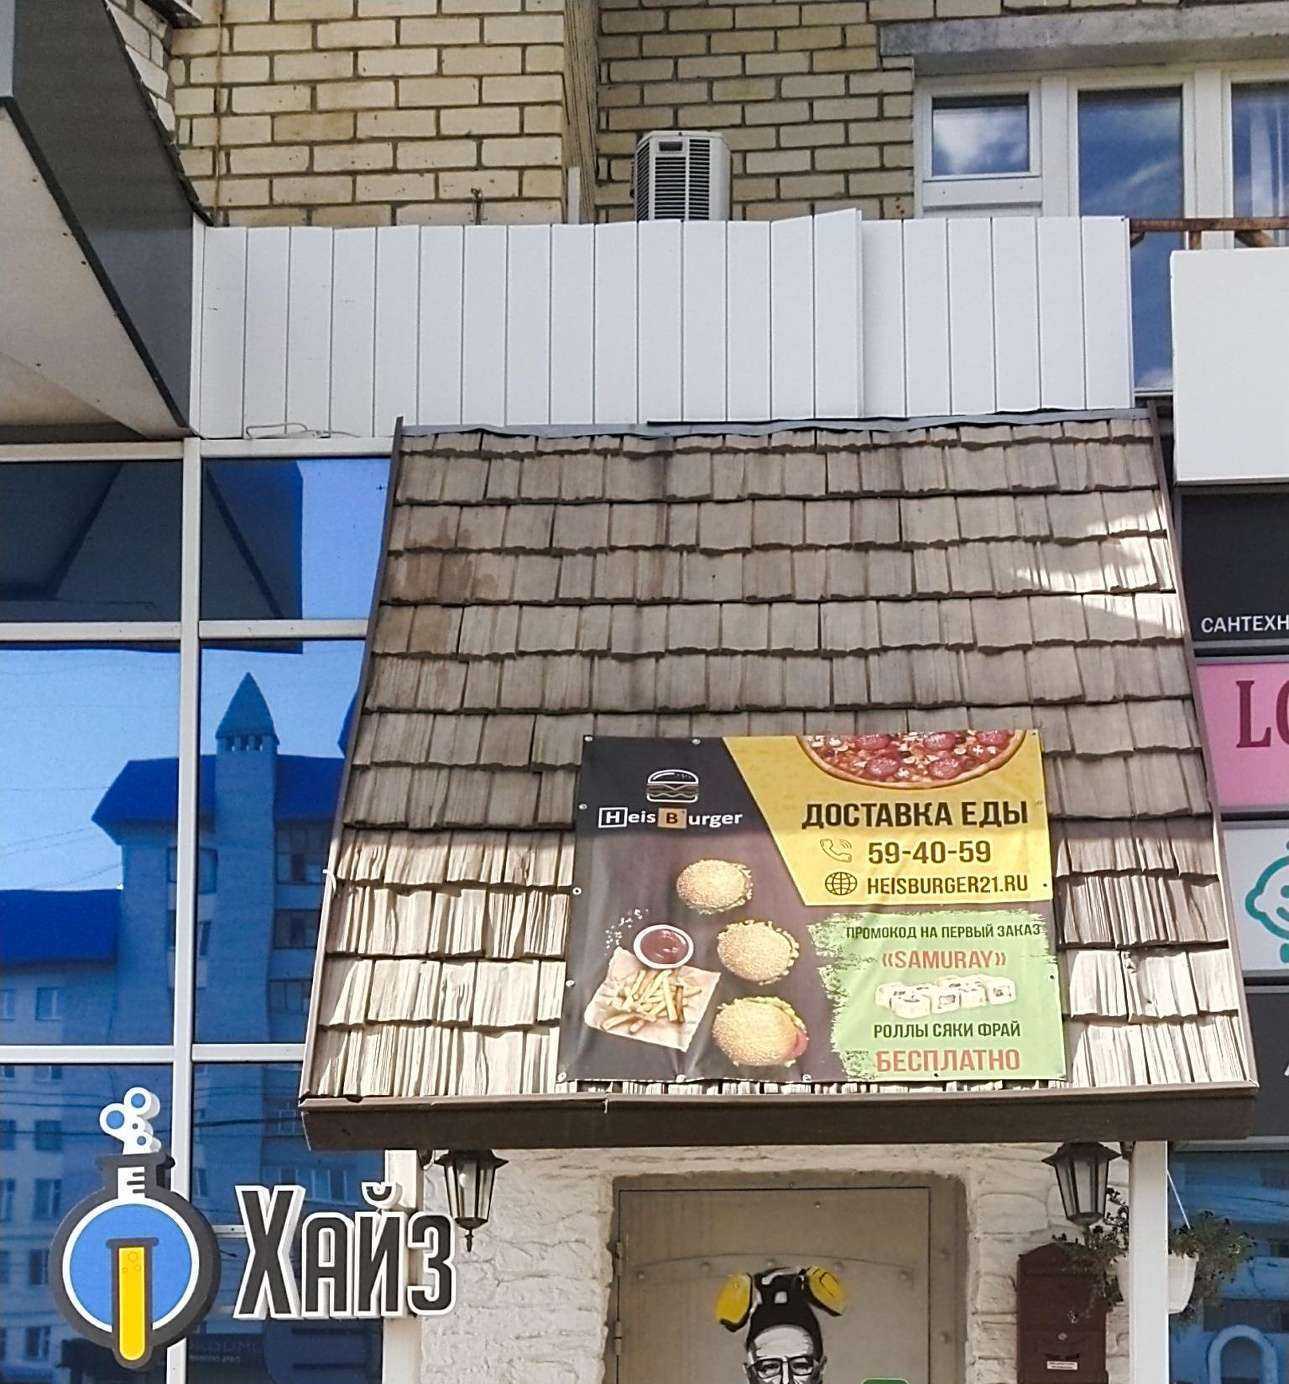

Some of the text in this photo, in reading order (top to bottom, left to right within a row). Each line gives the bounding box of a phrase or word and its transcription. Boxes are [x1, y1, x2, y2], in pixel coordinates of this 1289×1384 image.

[1200, 614, 1289, 633] САНТЕХН
[801, 801, 1028, 830] ДОСТАВКА ЕДЫ
[868, 840, 991, 864] 59-40-59
[867, 874, 1028, 895] HEISBURGER21.RU
[846, 922, 1041, 939] ПРОМОКОД НА ПЕРВЫЙ ЗАКАЗ
[881, 950, 1007, 969] «SAMURAY»
[873, 1020, 1021, 1039] РОЛЛЫ СЯКИ ФРАЙ
[876, 1048, 1021, 1073] БЕСПЛАТНО
